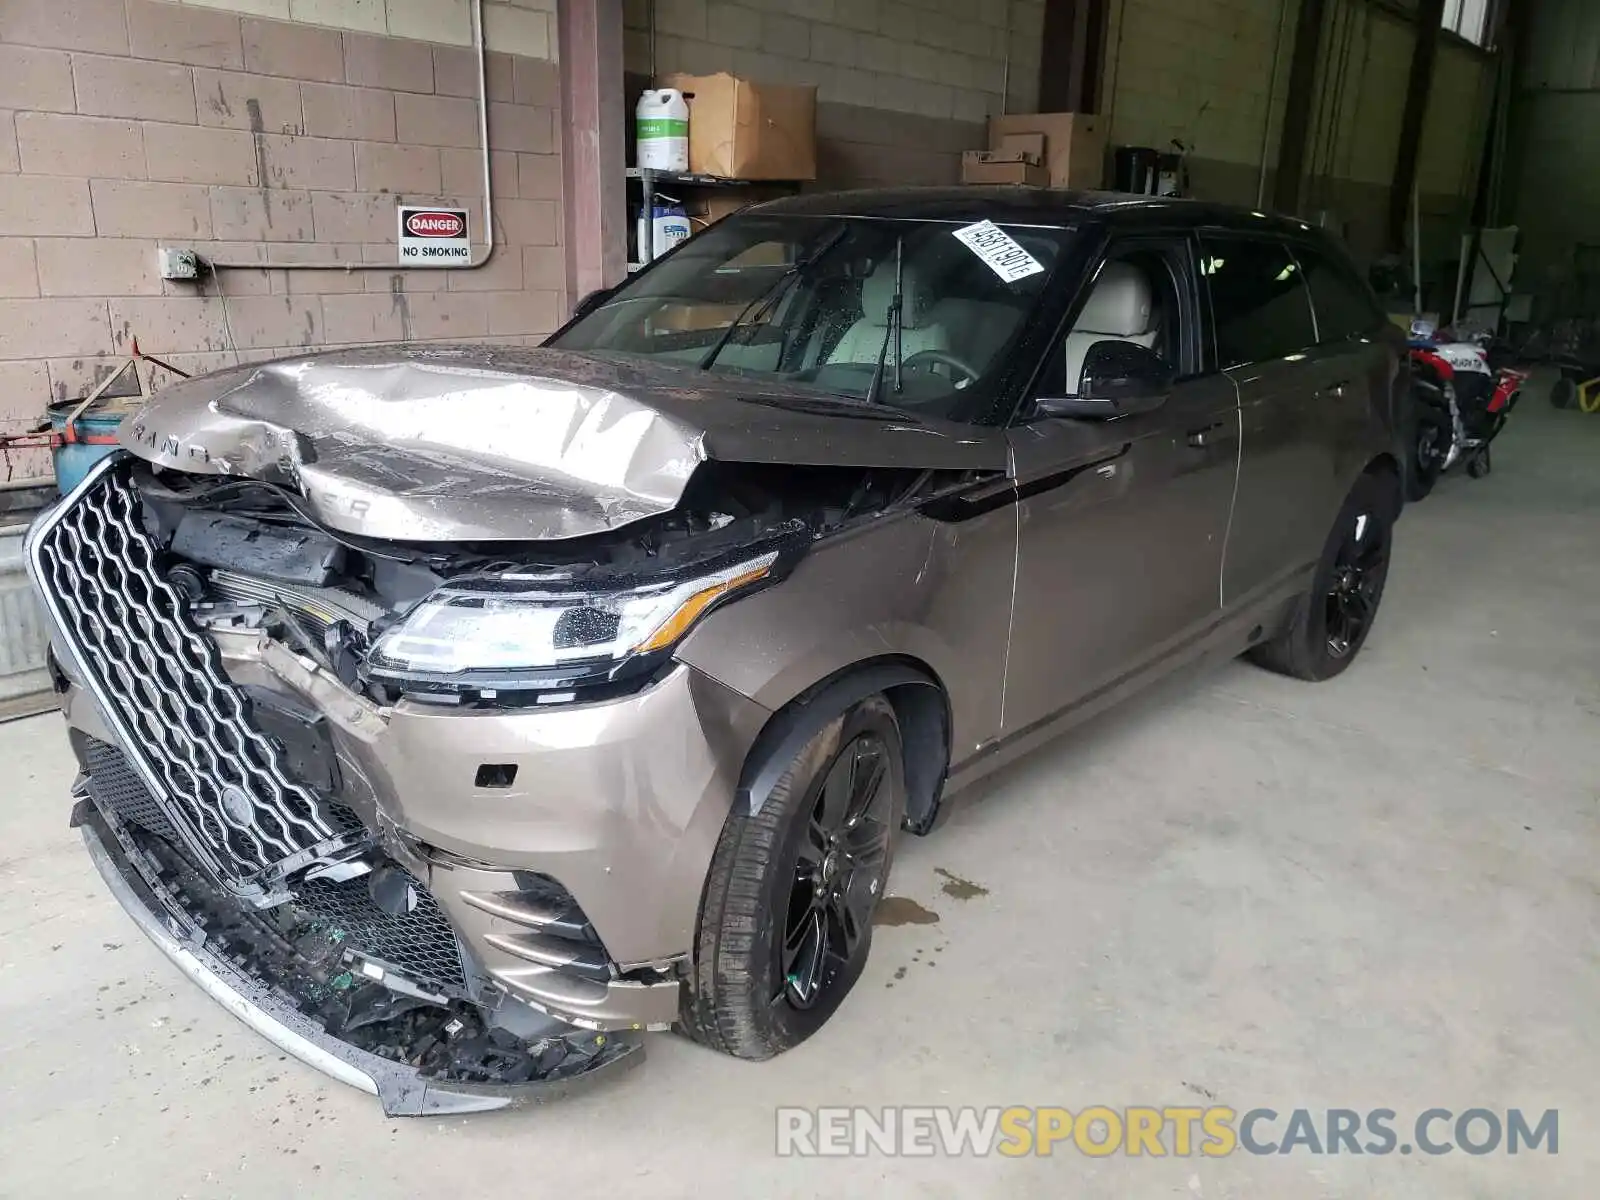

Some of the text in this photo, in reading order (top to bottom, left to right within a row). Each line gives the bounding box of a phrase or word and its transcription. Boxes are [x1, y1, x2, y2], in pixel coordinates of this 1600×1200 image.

[412, 218, 459, 230] DANGER
[403, 246, 468, 257] NO SMOKING
[974, 229, 1034, 271] 45811901
